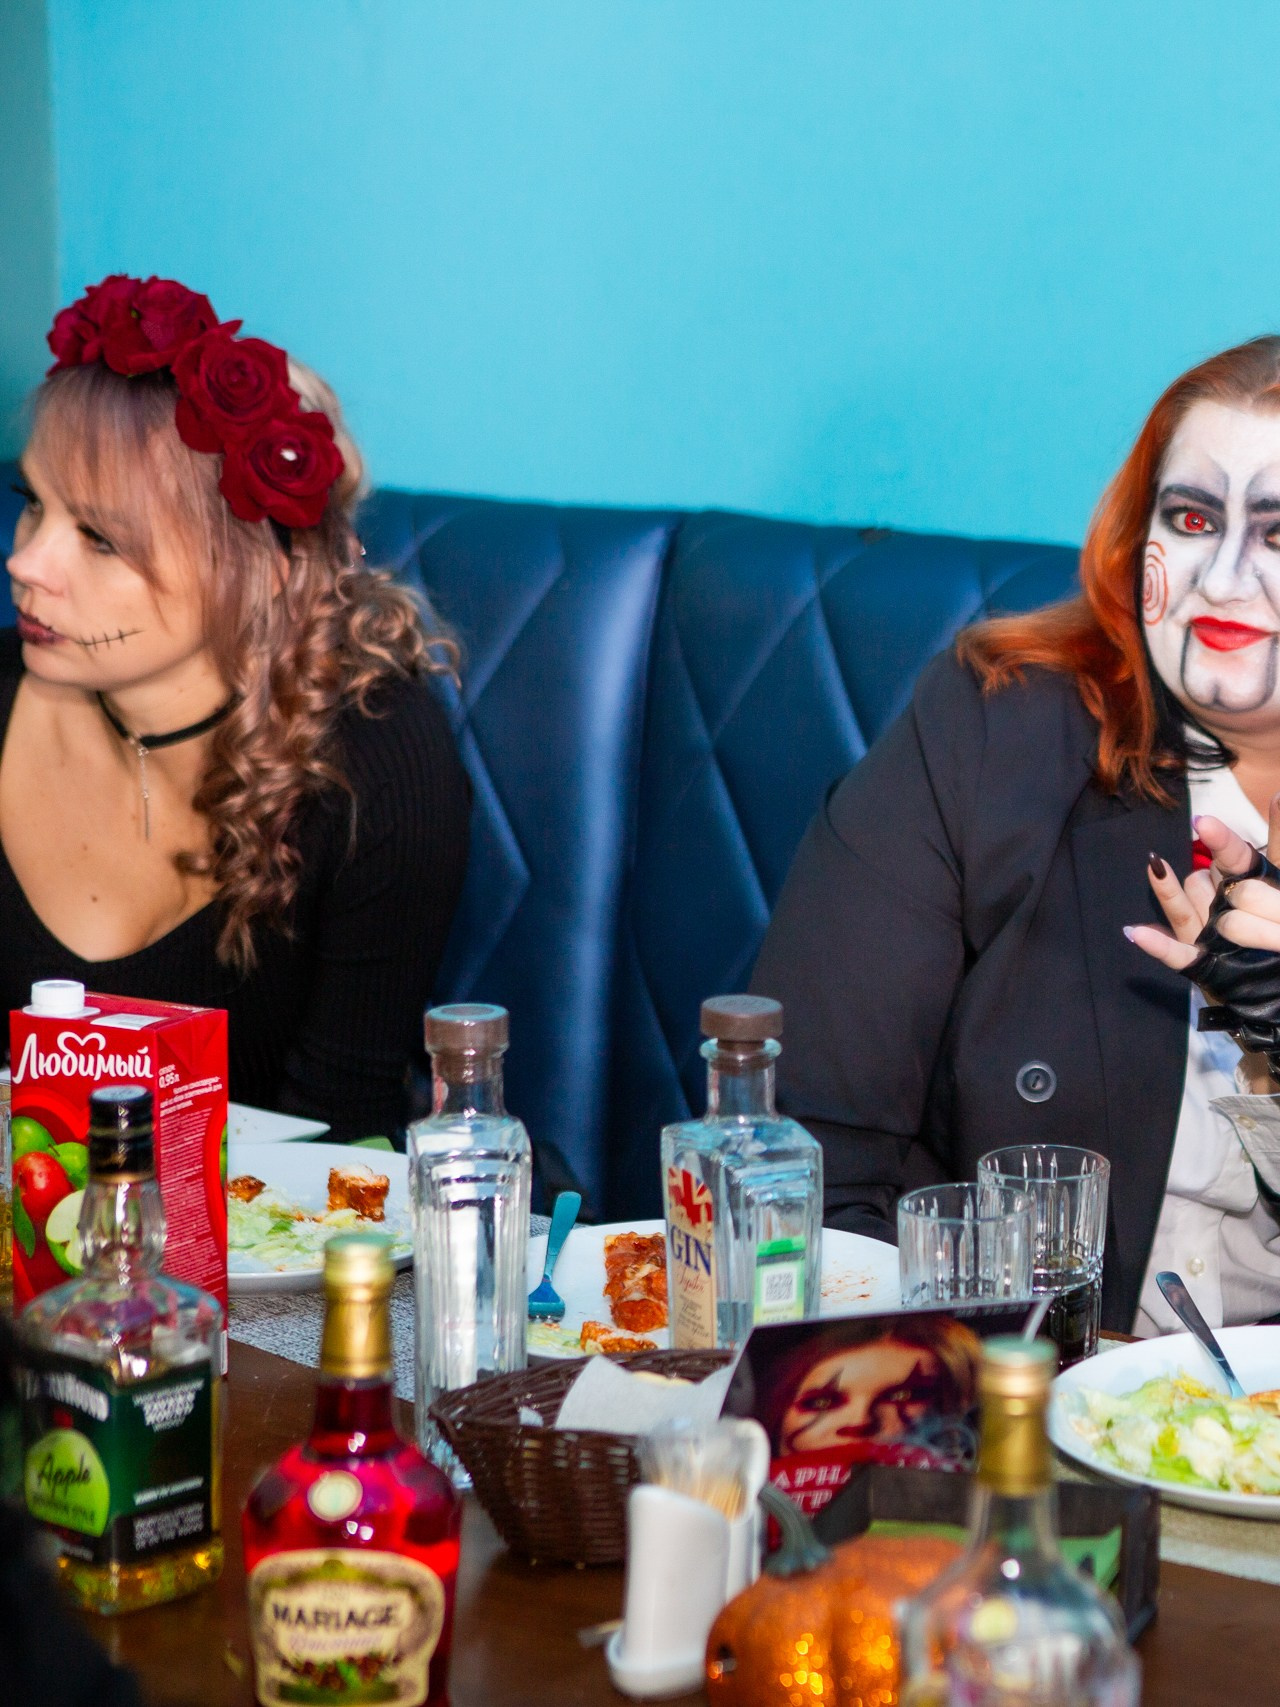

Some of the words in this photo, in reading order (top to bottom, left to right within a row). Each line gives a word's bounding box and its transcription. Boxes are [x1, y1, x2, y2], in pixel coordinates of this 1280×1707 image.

[12, 1031, 155, 1084] Любимый
[670, 1224, 712, 1277] GIN
[37, 1452, 91, 1500] Apple
